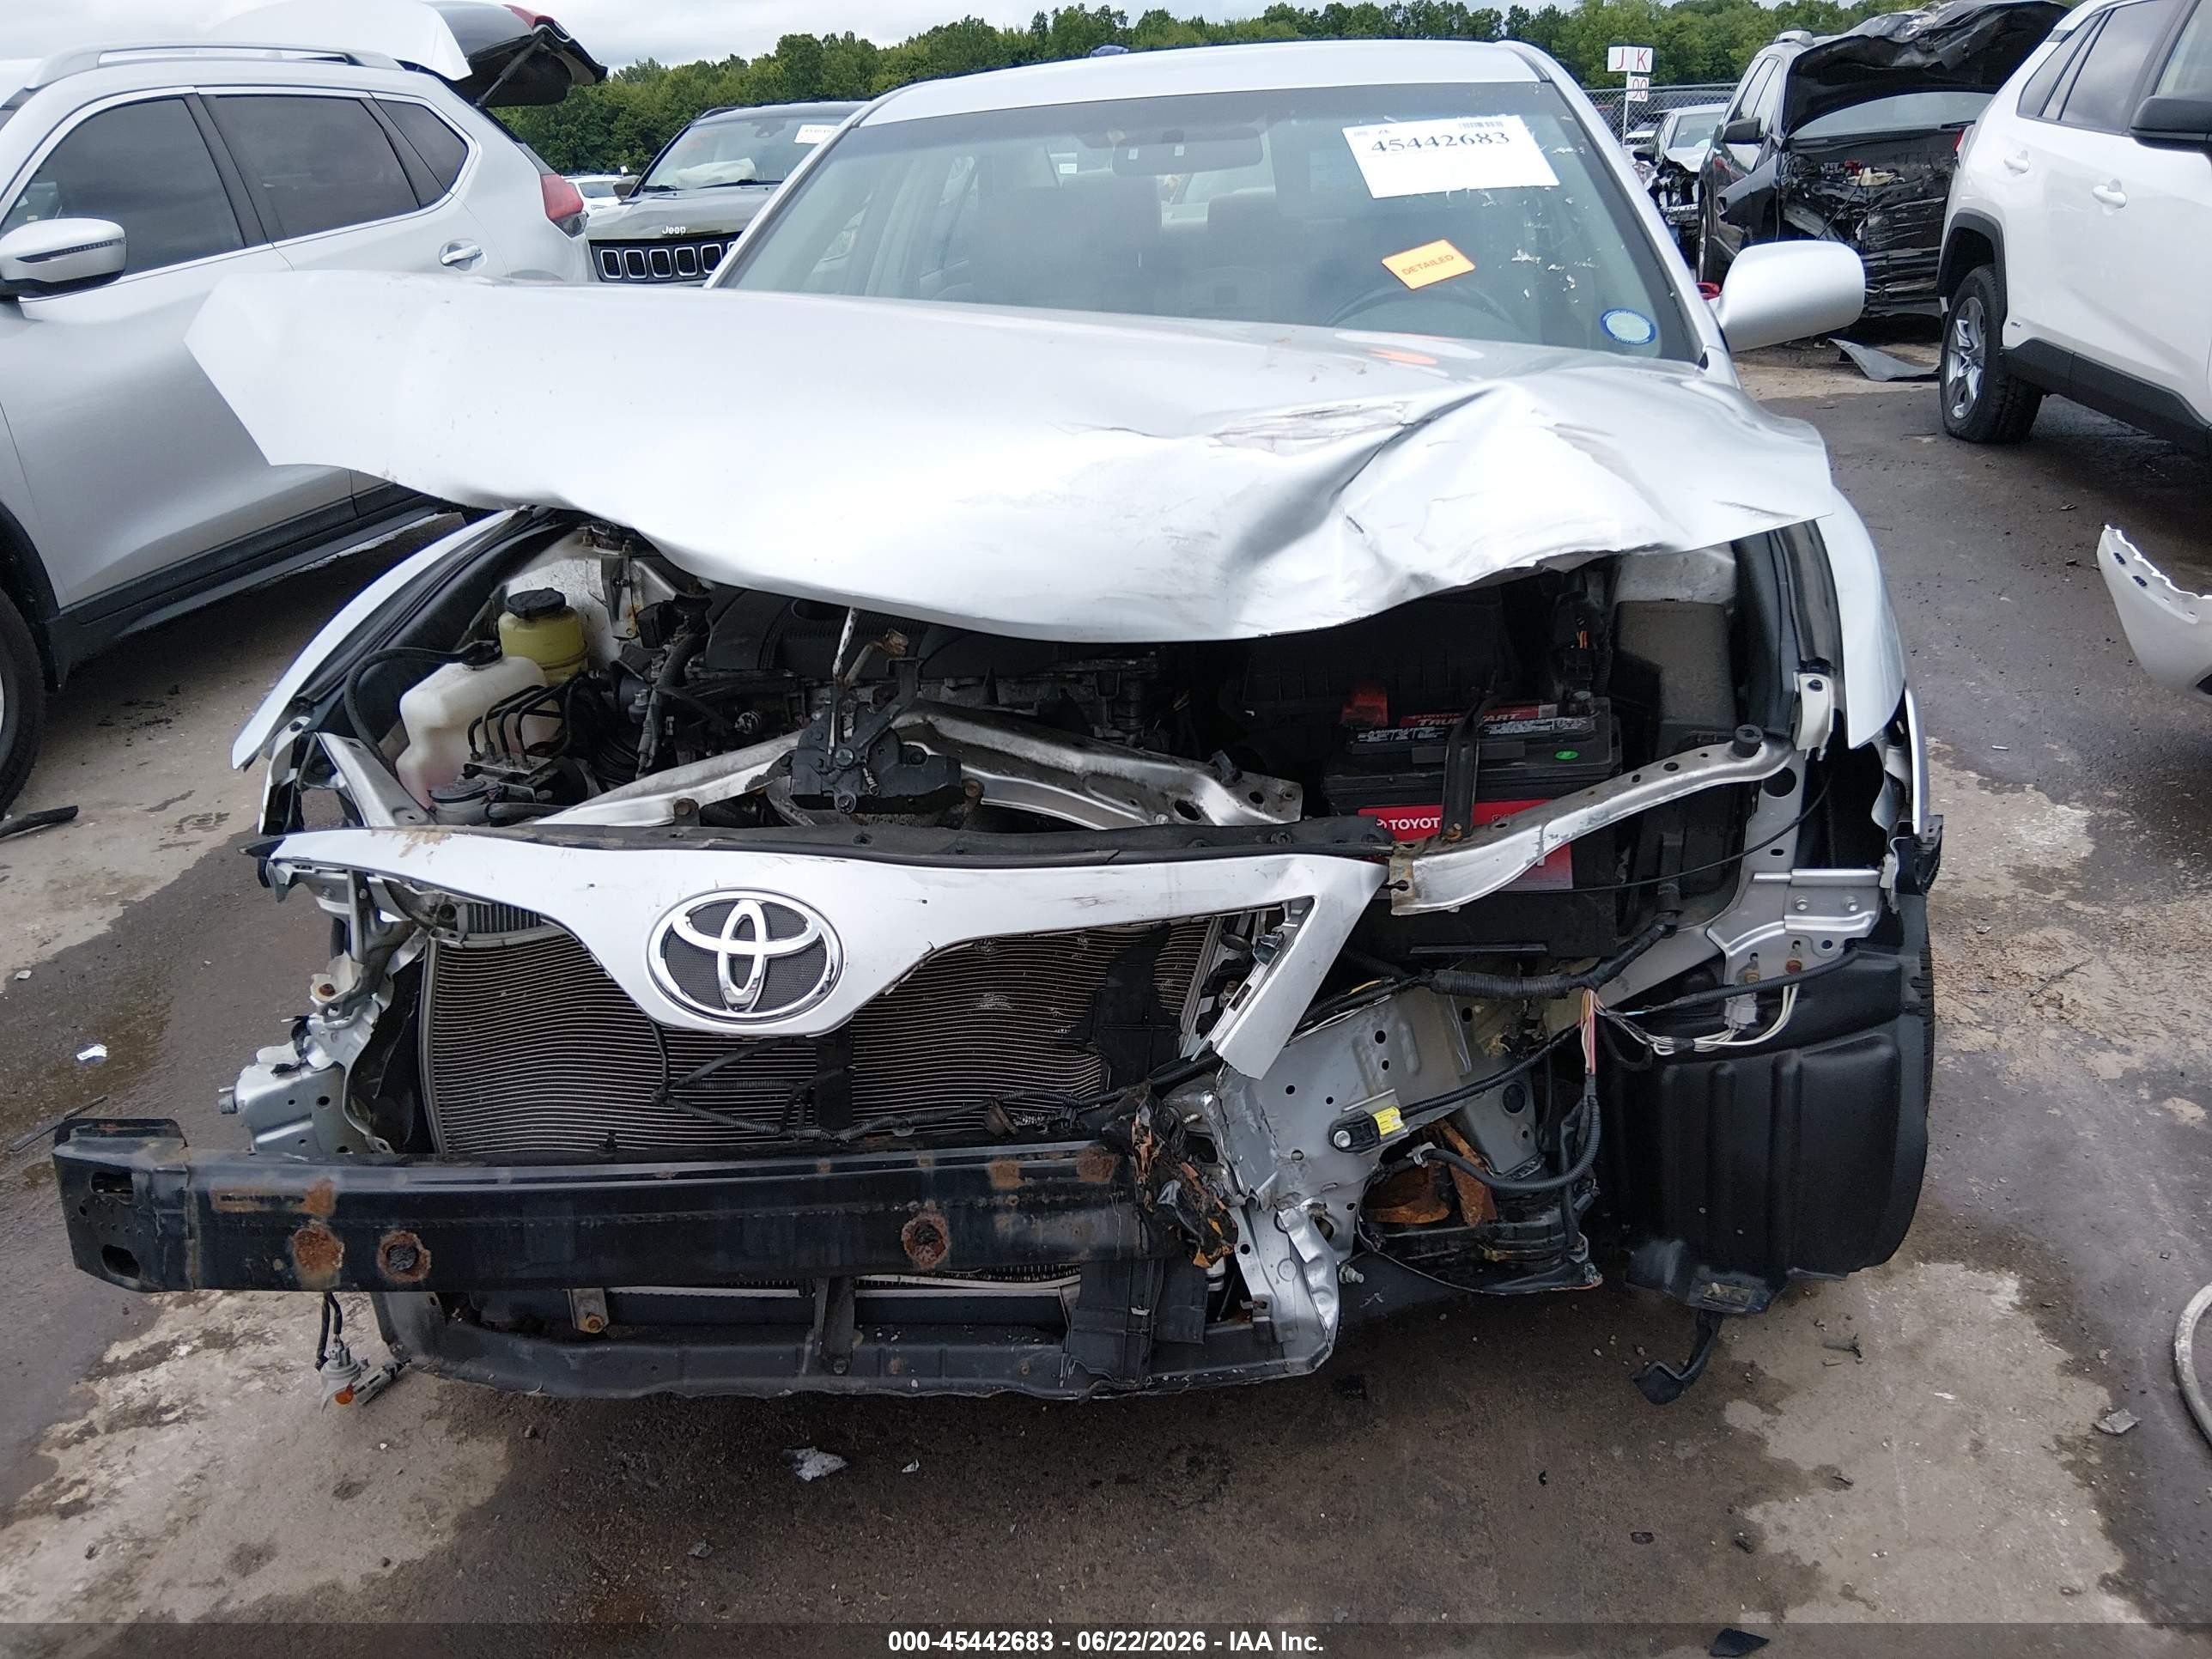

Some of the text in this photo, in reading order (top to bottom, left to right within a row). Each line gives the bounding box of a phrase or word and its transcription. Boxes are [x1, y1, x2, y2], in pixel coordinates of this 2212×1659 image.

[1615, 47, 1648, 70] J K
[1632, 77, 1648, 100] 90
[1371, 131, 1510, 152] 45442683
[661, 225, 686, 236] Jeep
[1401, 254, 1455, 276] DETAILED
[1388, 817, 1441, 830] TOYOT
